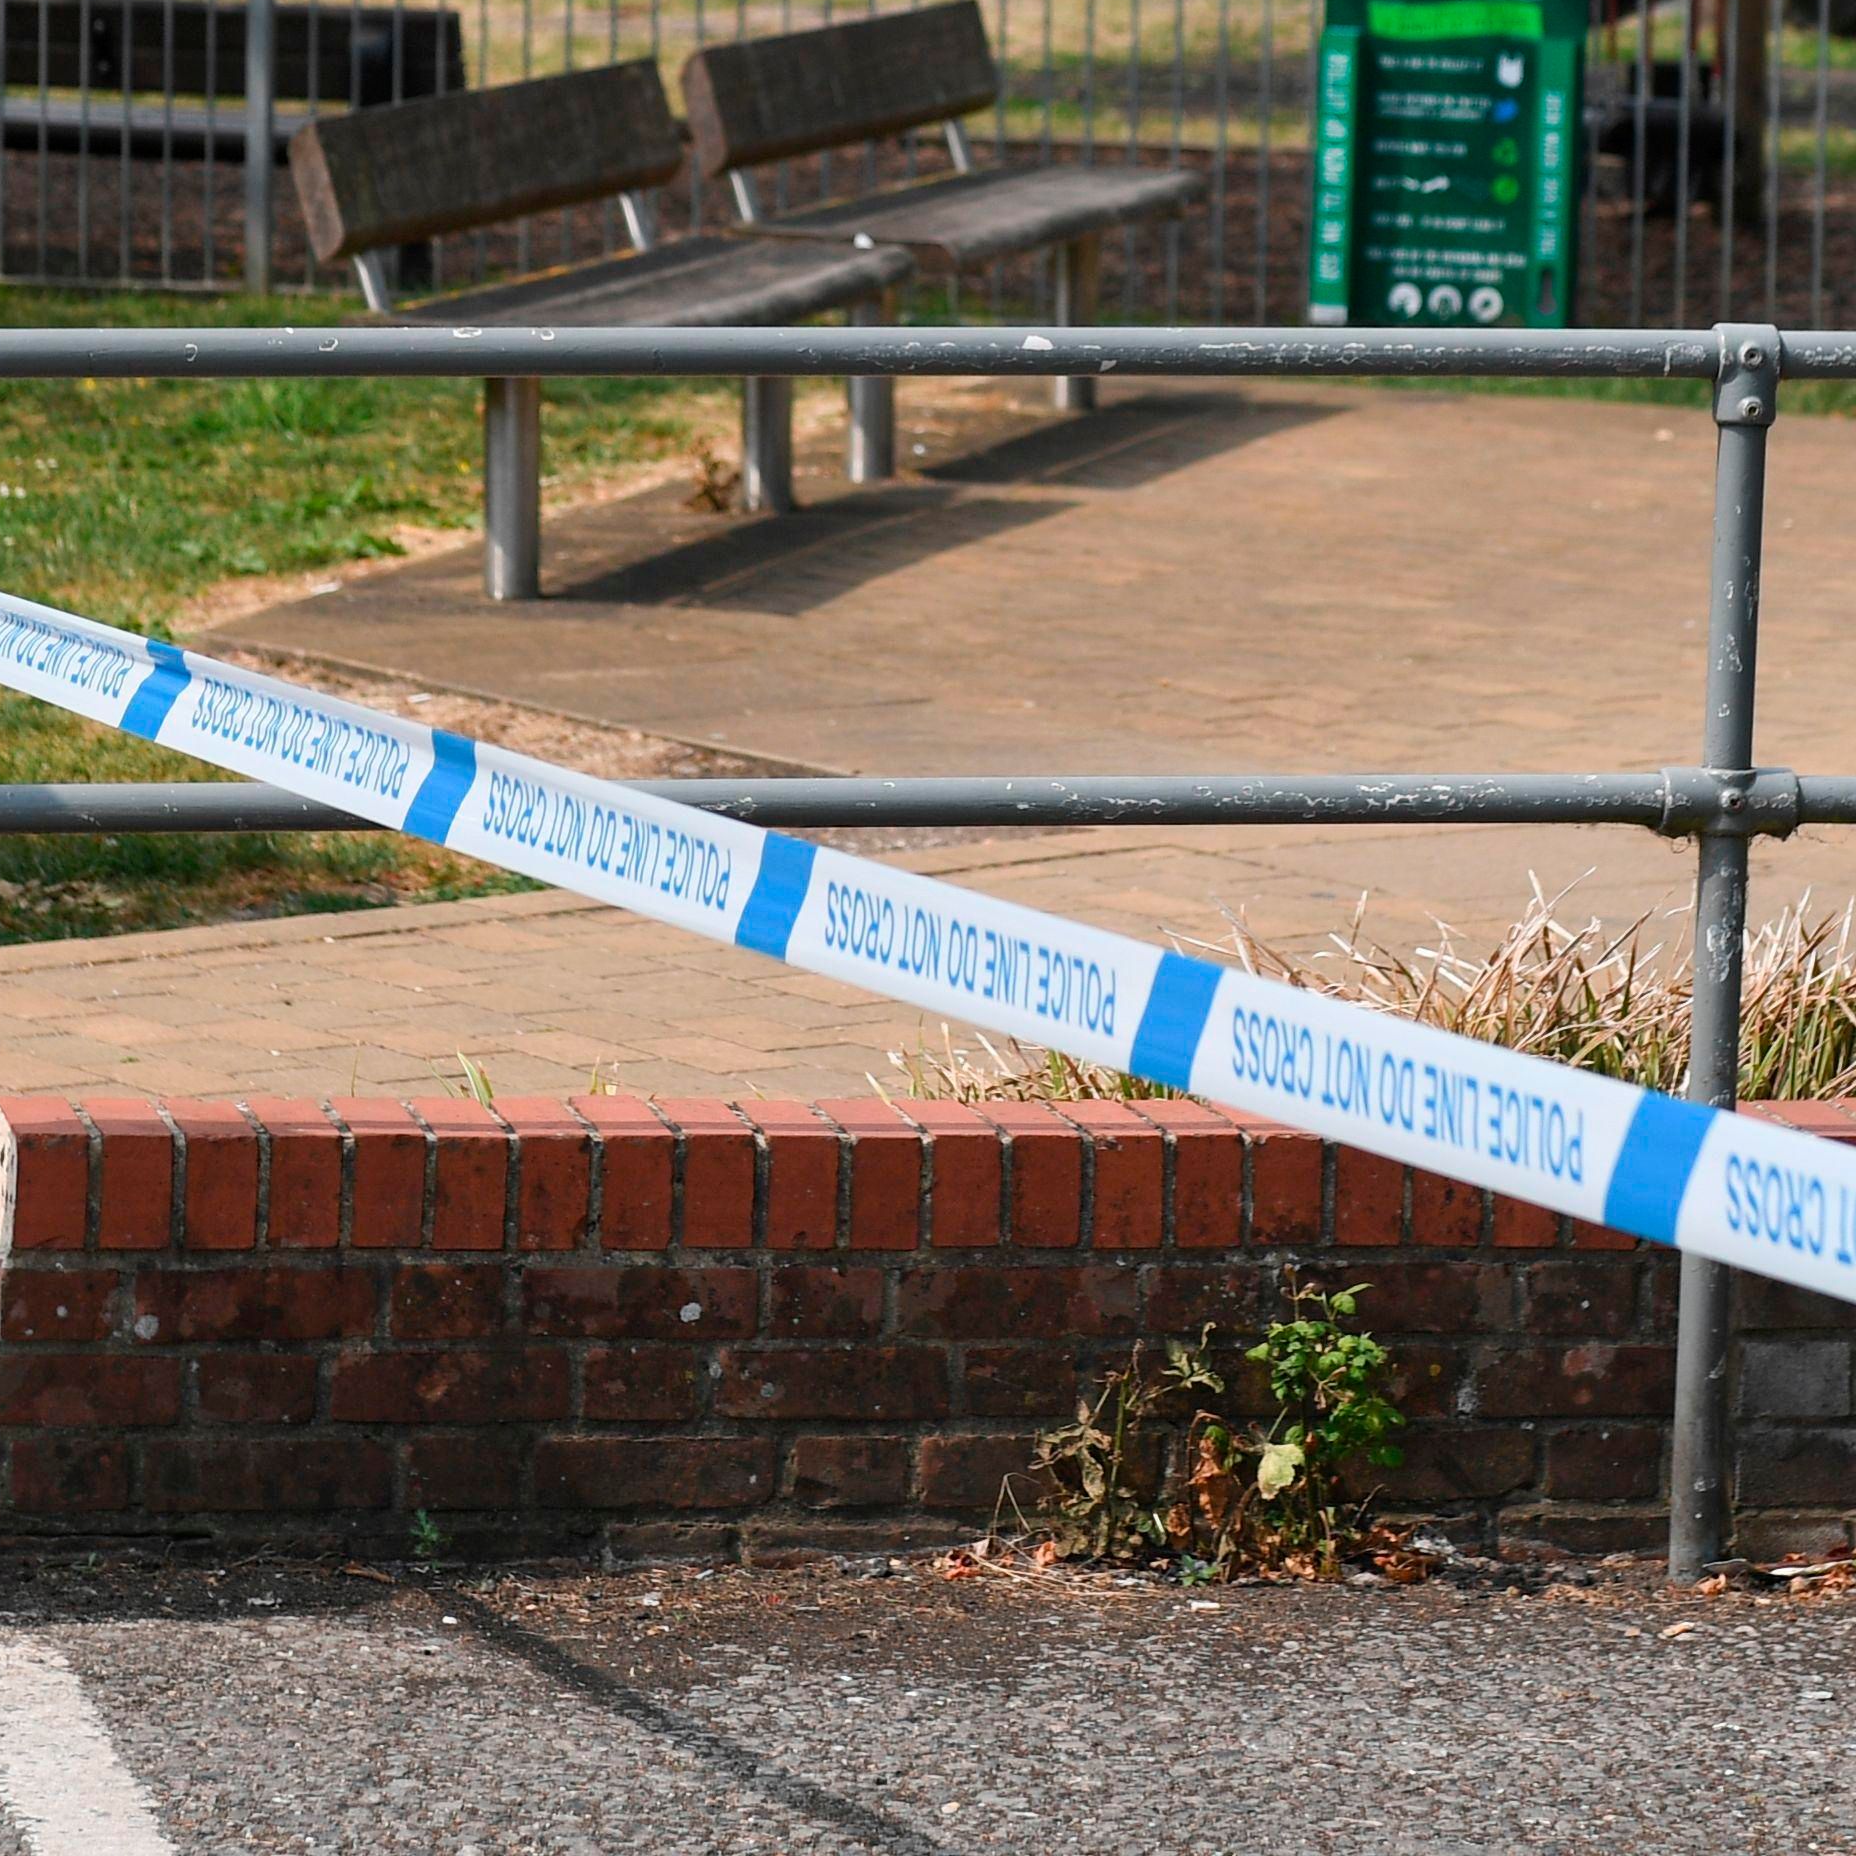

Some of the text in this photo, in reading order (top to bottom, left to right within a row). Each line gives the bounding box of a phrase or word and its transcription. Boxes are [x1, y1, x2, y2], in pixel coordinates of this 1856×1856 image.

[192, 678, 410, 800] POLICE LINE DO NOT CROSS
[482, 770, 732, 911] POLICE LINE DO NOT CROSS
[824, 881, 1117, 1038] POLICE LINE DO NOT CROSS
[1231, 1006, 1584, 1184] POLICE LINE DO NOT CROSS
[1724, 1151, 1828, 1258] CROSS
